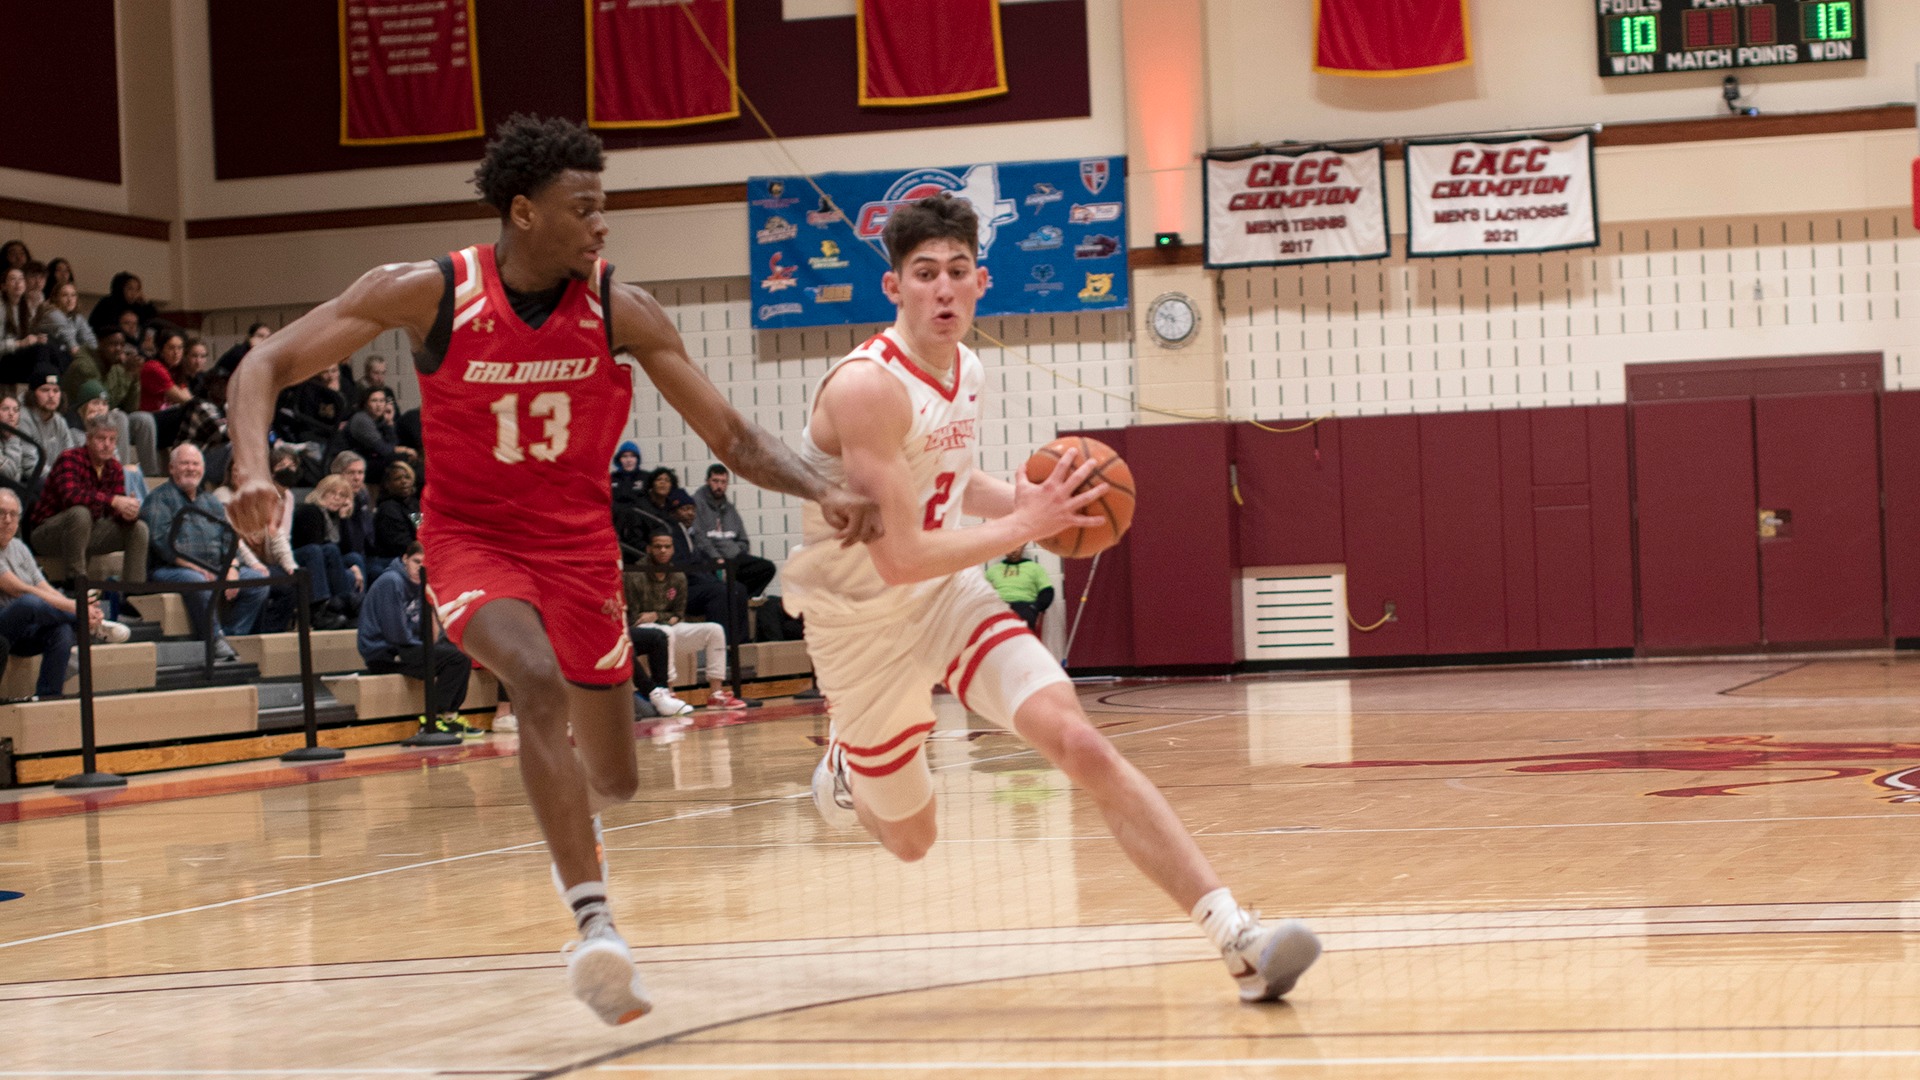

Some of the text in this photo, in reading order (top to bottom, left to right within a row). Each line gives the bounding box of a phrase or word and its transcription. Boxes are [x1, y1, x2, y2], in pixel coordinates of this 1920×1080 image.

[1817, 2, 1852, 40] 10
[1622, 15, 1657, 54] 10
[1666, 44, 1798, 71] MATCH POINTS
[1809, 41, 1852, 60] WON
[1611, 55, 1654, 74] WON
[1246, 157, 1344, 188] CACC
[1450, 146, 1550, 175] CACC
[1228, 186, 1362, 211] CHAMPION
[1431, 175, 1570, 199] CHAMPION
[1246, 215, 1346, 234] MEN'S TENNIS
[1434, 202, 1568, 223] MEN'S LACROSSE
[1280, 239, 1313, 254] 2017
[1483, 228, 1518, 242] 2021
[490, 391, 571, 464] 13
[922, 471, 955, 531] 2
